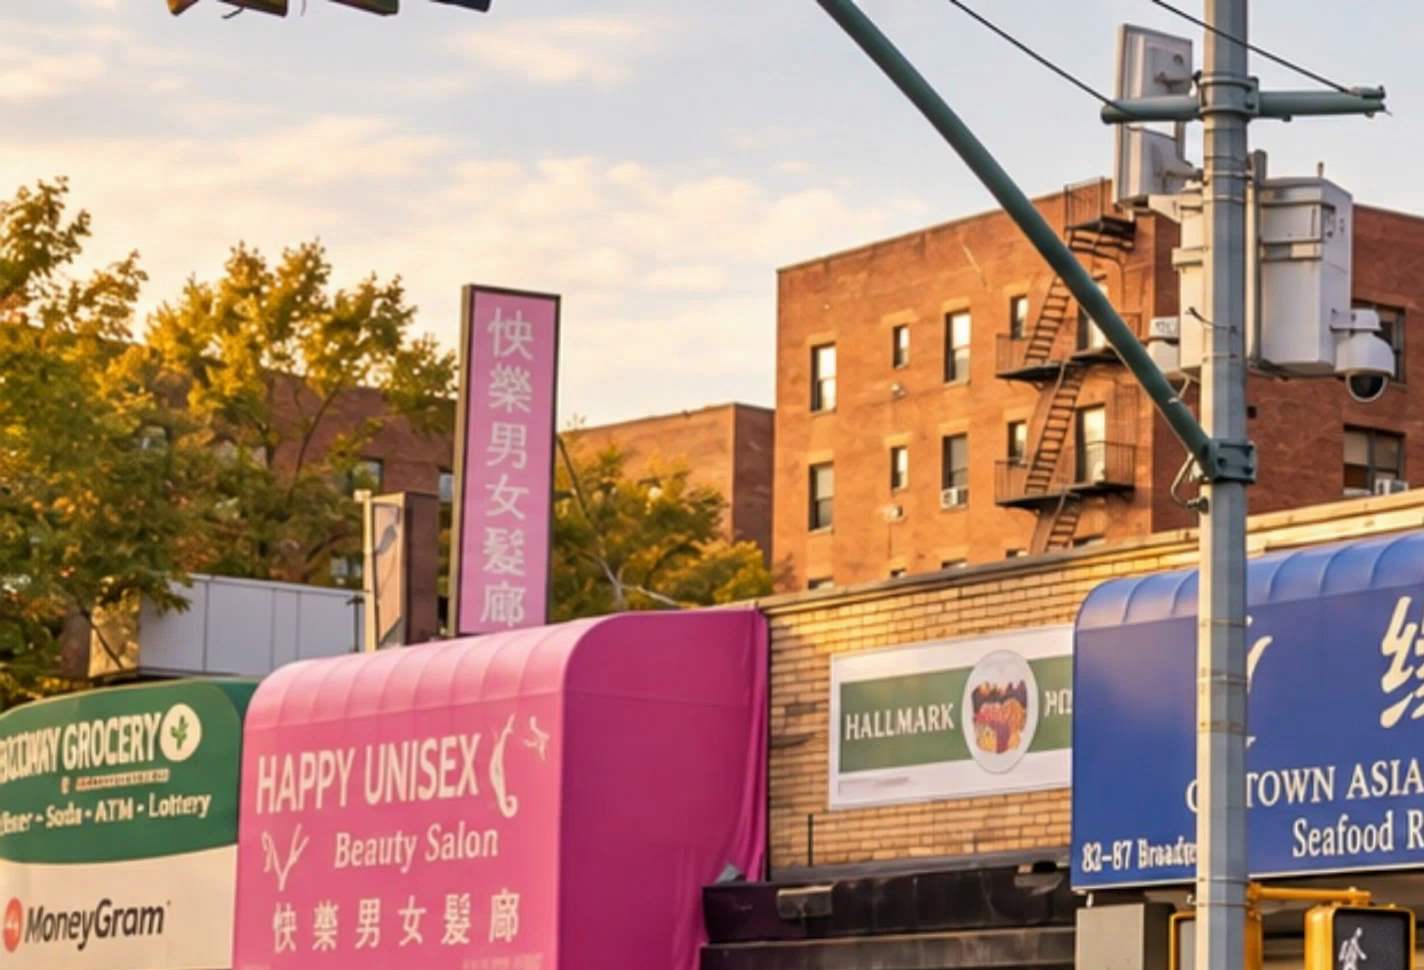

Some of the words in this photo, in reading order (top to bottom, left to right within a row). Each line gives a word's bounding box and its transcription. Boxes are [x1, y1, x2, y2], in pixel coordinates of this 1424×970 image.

[62, 712, 162, 770] GROCERY
[845, 703, 954, 740] HALLMARK
[256, 747, 356, 814] HAPPY
[364, 733, 482, 805] UNISEX
[46, 803, 82, 828] Soda
[95, 798, 134, 823] ATM
[149, 793, 212, 818] Lottery
[1292, 808, 1396, 858] Seafood
[334, 829, 417, 874] Beauty
[425, 820, 499, 862] Salon
[24, 897, 165, 951] MoneyGram
